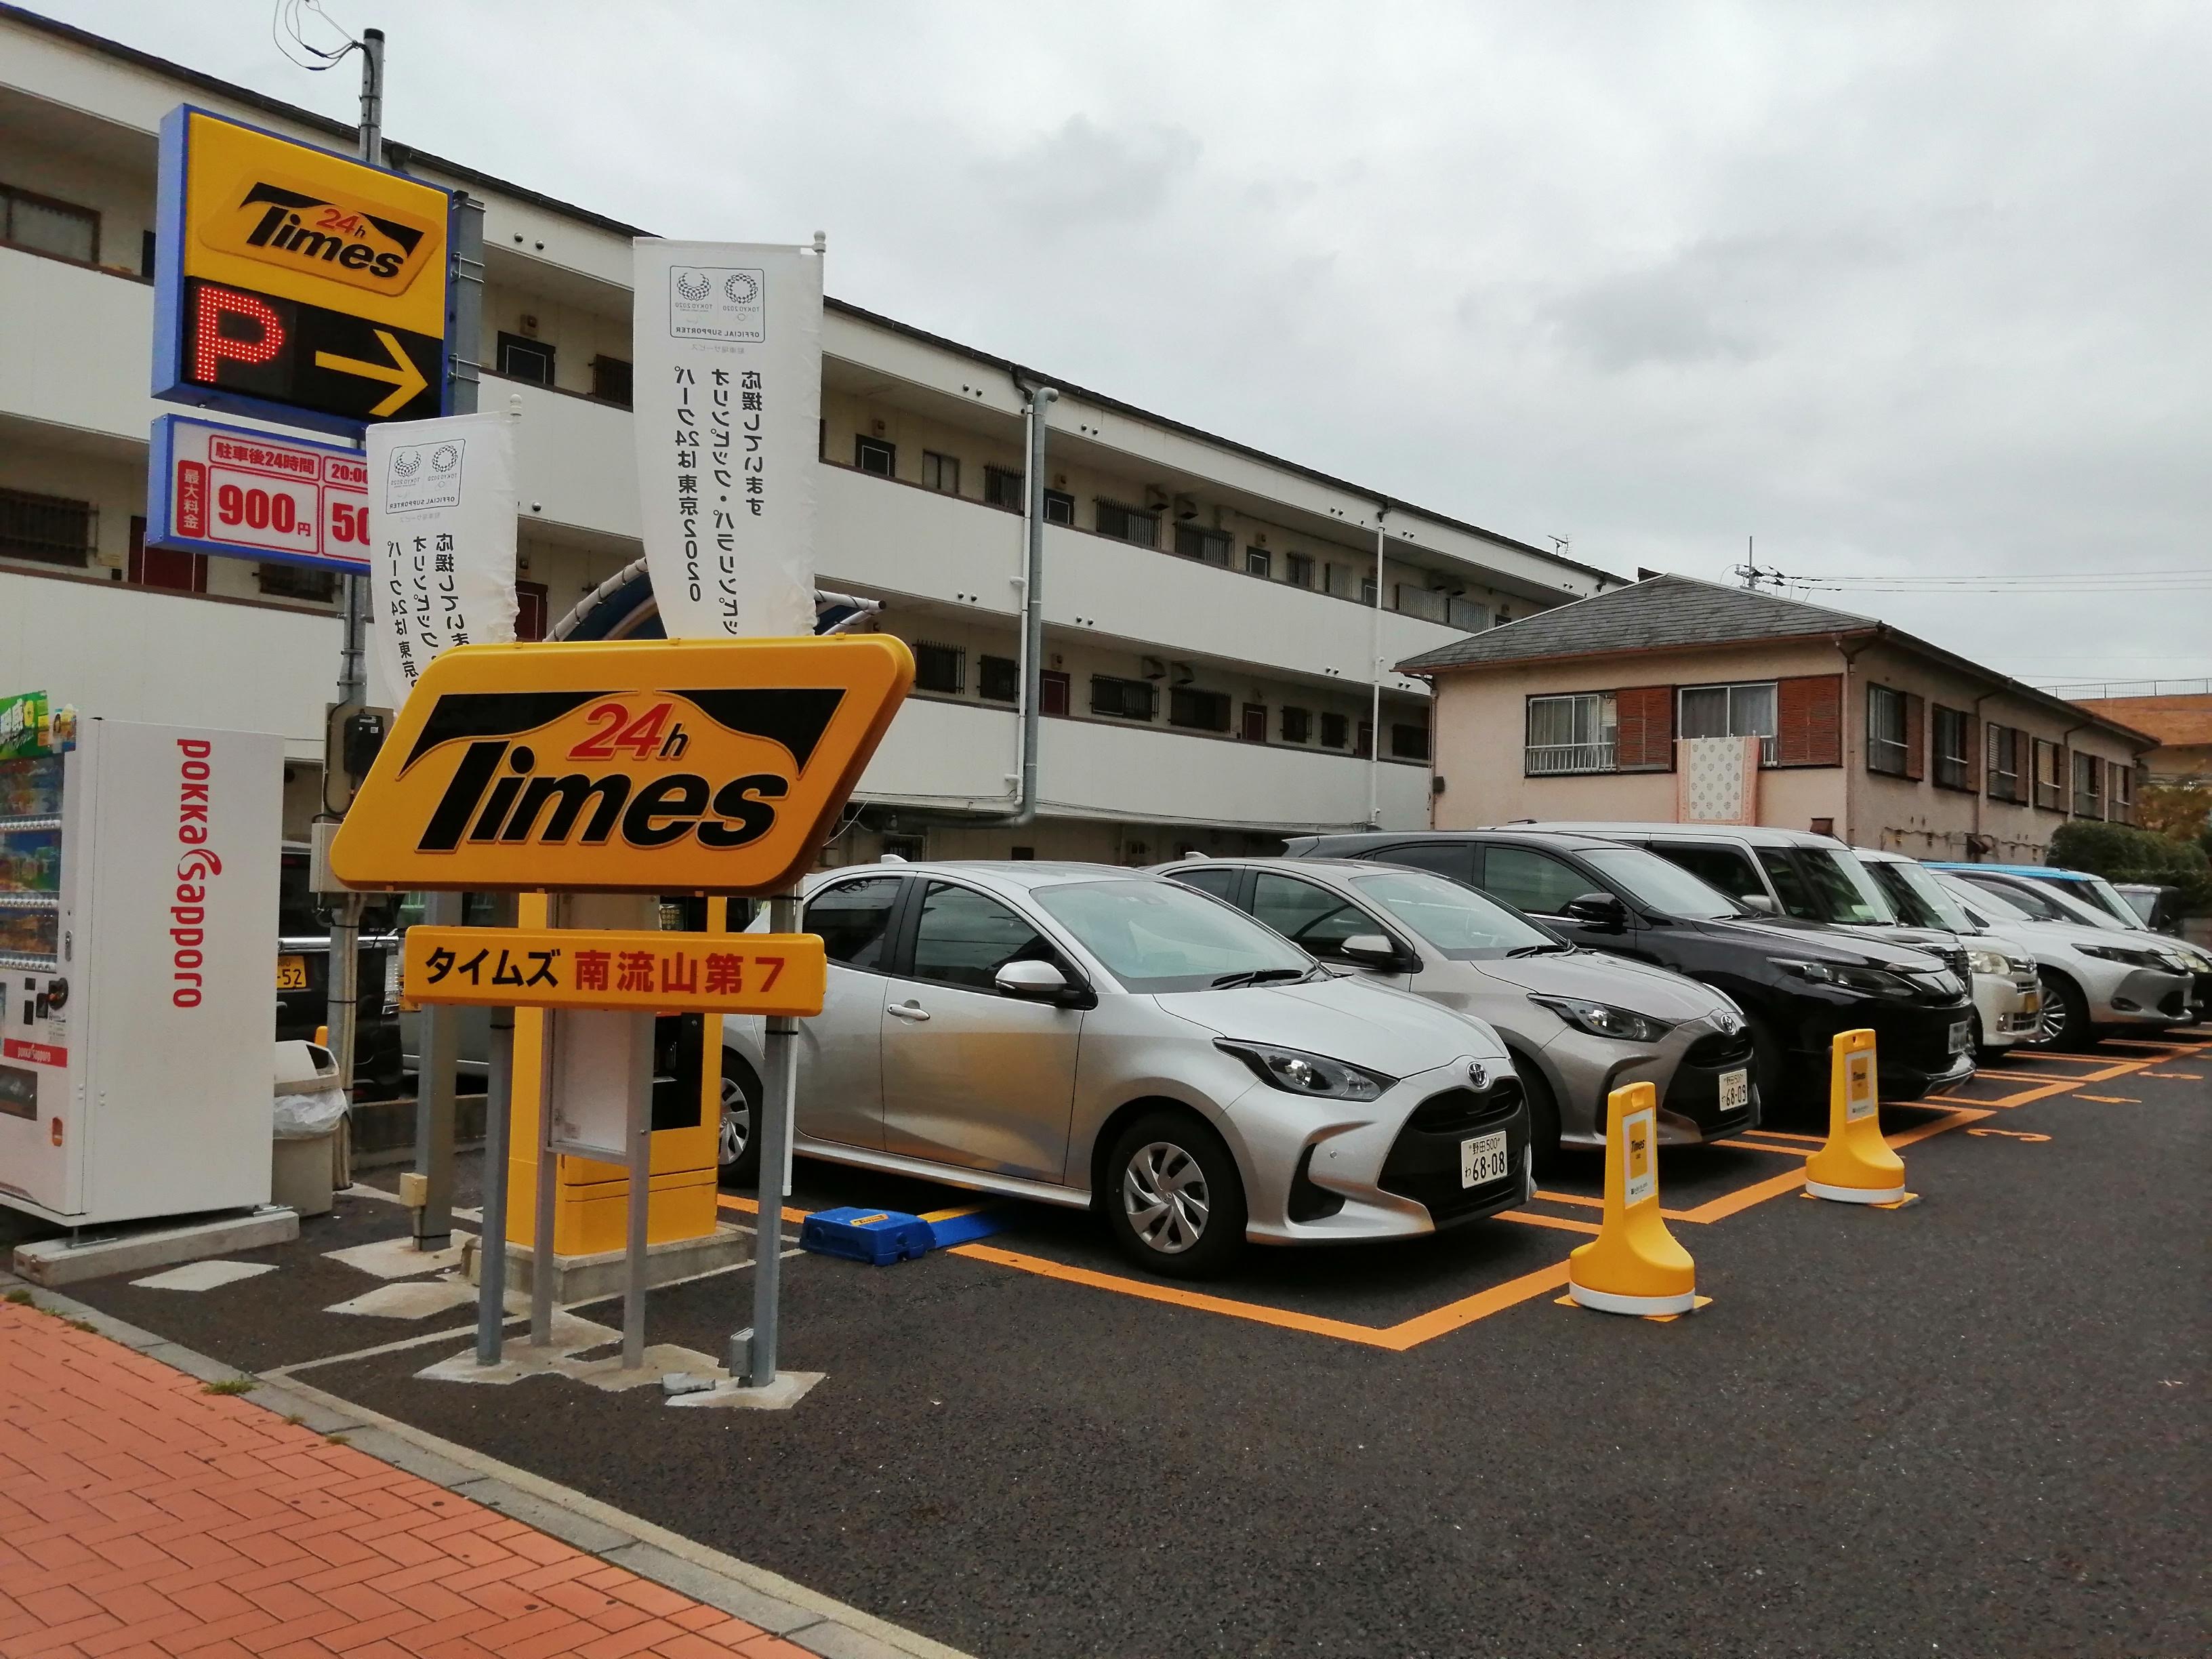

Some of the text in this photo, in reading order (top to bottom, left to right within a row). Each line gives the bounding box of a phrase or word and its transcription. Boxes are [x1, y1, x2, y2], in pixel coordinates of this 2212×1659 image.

[246, 205, 404, 279] Times
[316, 208, 366, 238] 24h
[196, 287, 284, 383] P
[215, 442, 314, 474] 駐車後24時間
[184, 469, 199, 529] 最大料金
[569, 702, 691, 761] 24h
[416, 739, 790, 852] Times
[426, 947, 561, 987] タイムズ
